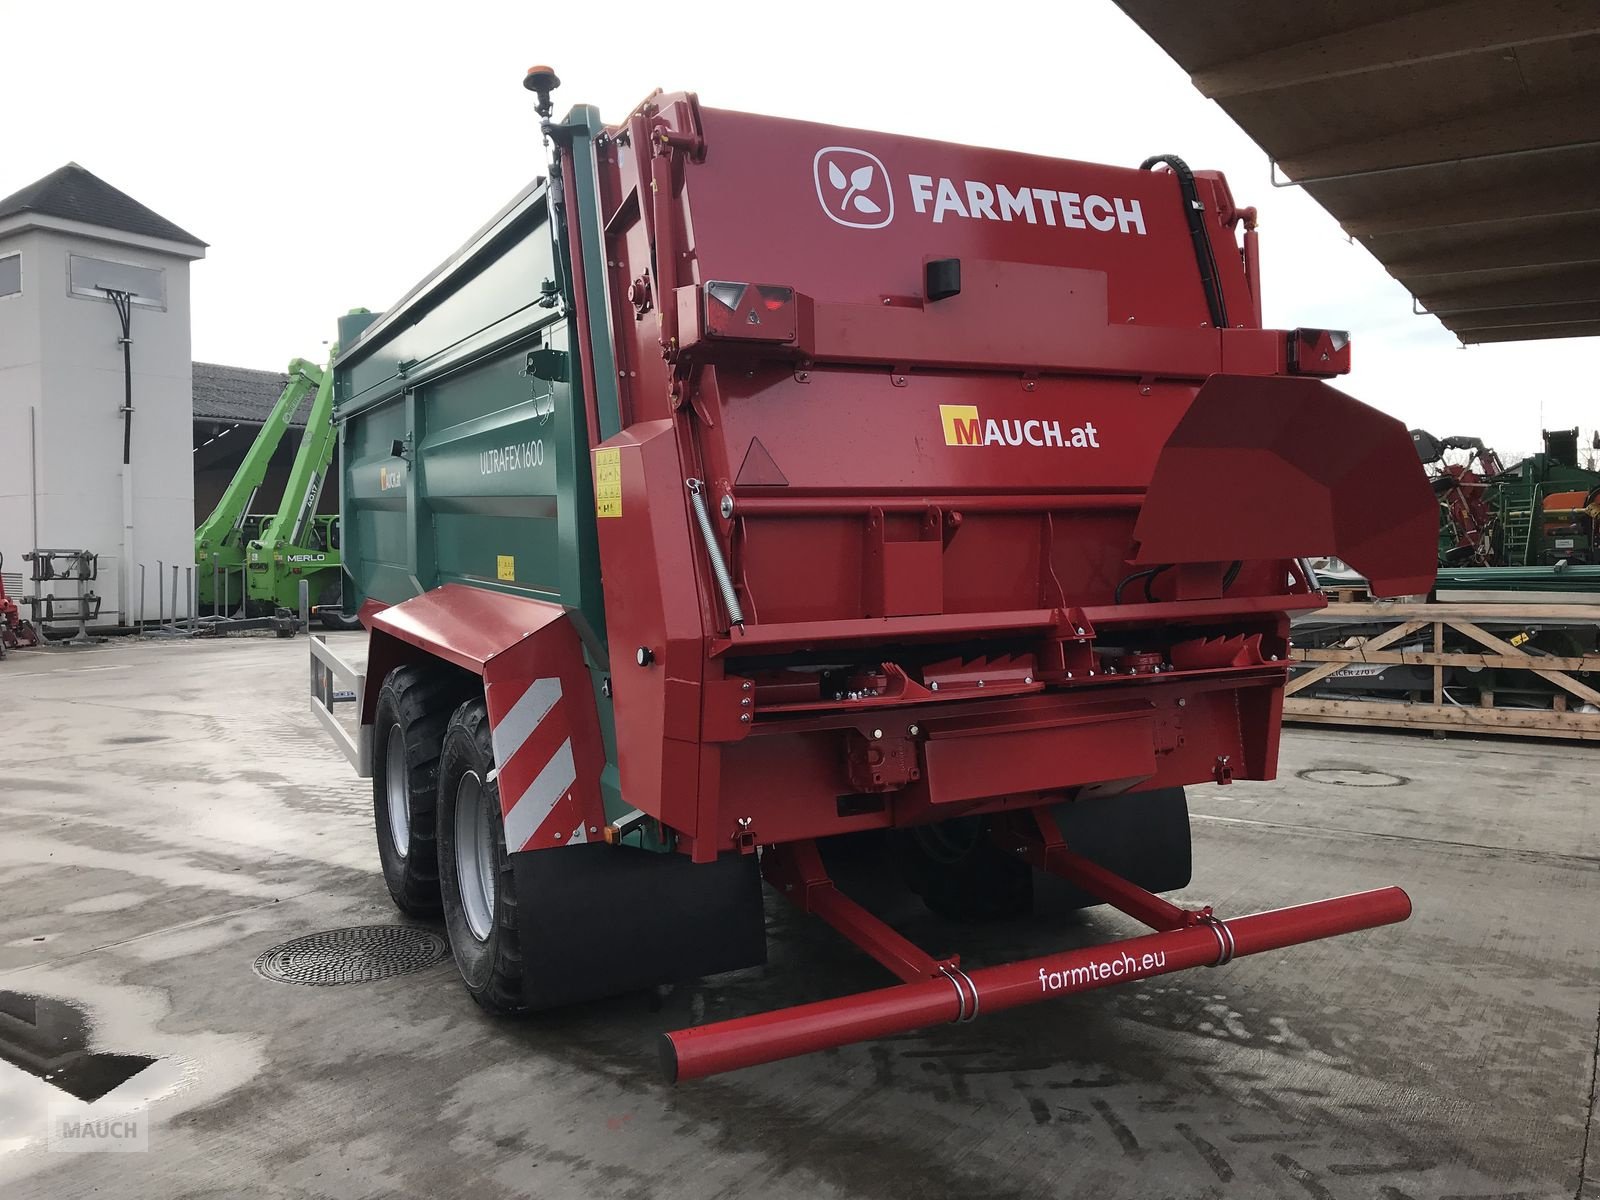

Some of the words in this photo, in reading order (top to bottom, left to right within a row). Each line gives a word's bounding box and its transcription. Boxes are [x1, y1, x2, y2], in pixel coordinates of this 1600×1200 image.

[908, 174, 1147, 235] FARMTECH
[953, 418, 1100, 448] MAUCH.at
[480, 444, 521, 475] ULTRAFEX
[521, 439, 544, 469] 1600
[307, 484, 319, 508] 40.17
[287, 554, 325, 562] MERLO
[1038, 951, 1166, 992] farmtech.eu
